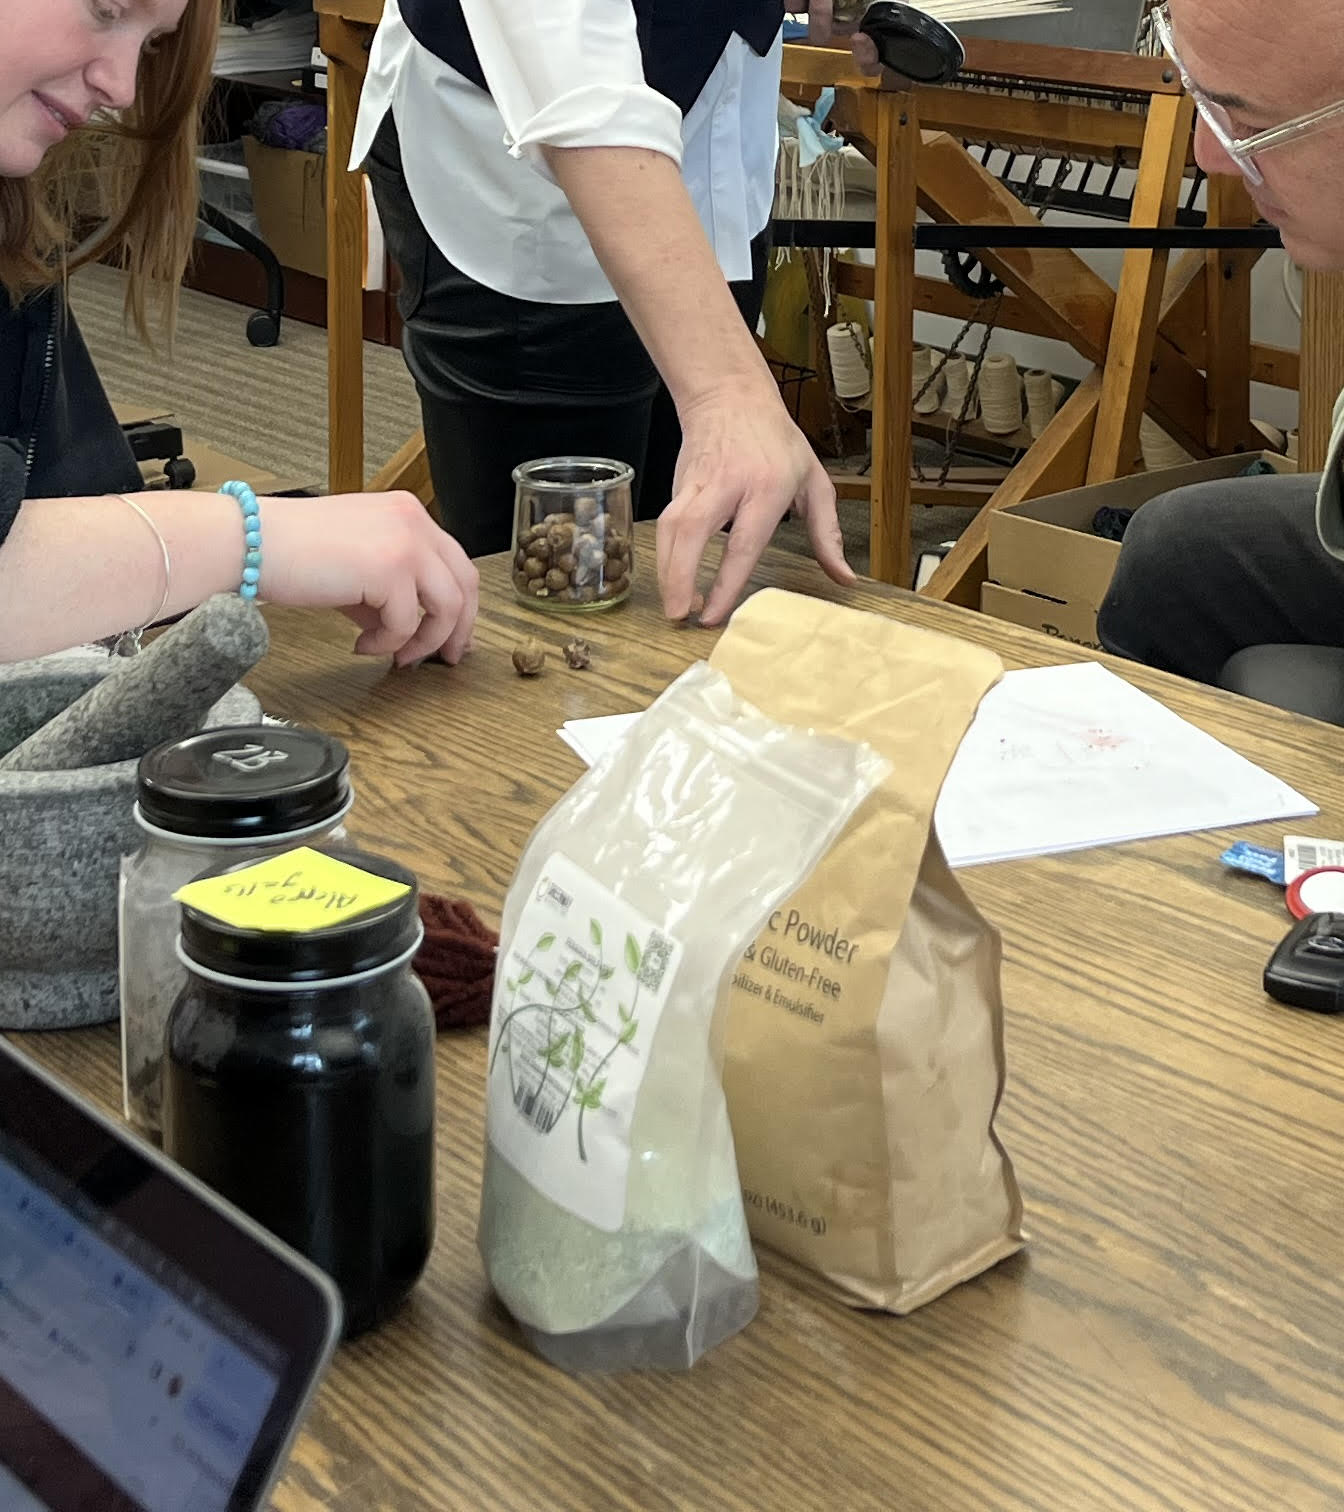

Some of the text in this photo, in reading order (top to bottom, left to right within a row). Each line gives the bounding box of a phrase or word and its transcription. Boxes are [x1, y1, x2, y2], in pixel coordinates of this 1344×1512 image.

[784, 909, 859, 964] Powder
[760, 945, 841, 998] Gluten-Free
[773, 988, 825, 1024] Emulsifier
